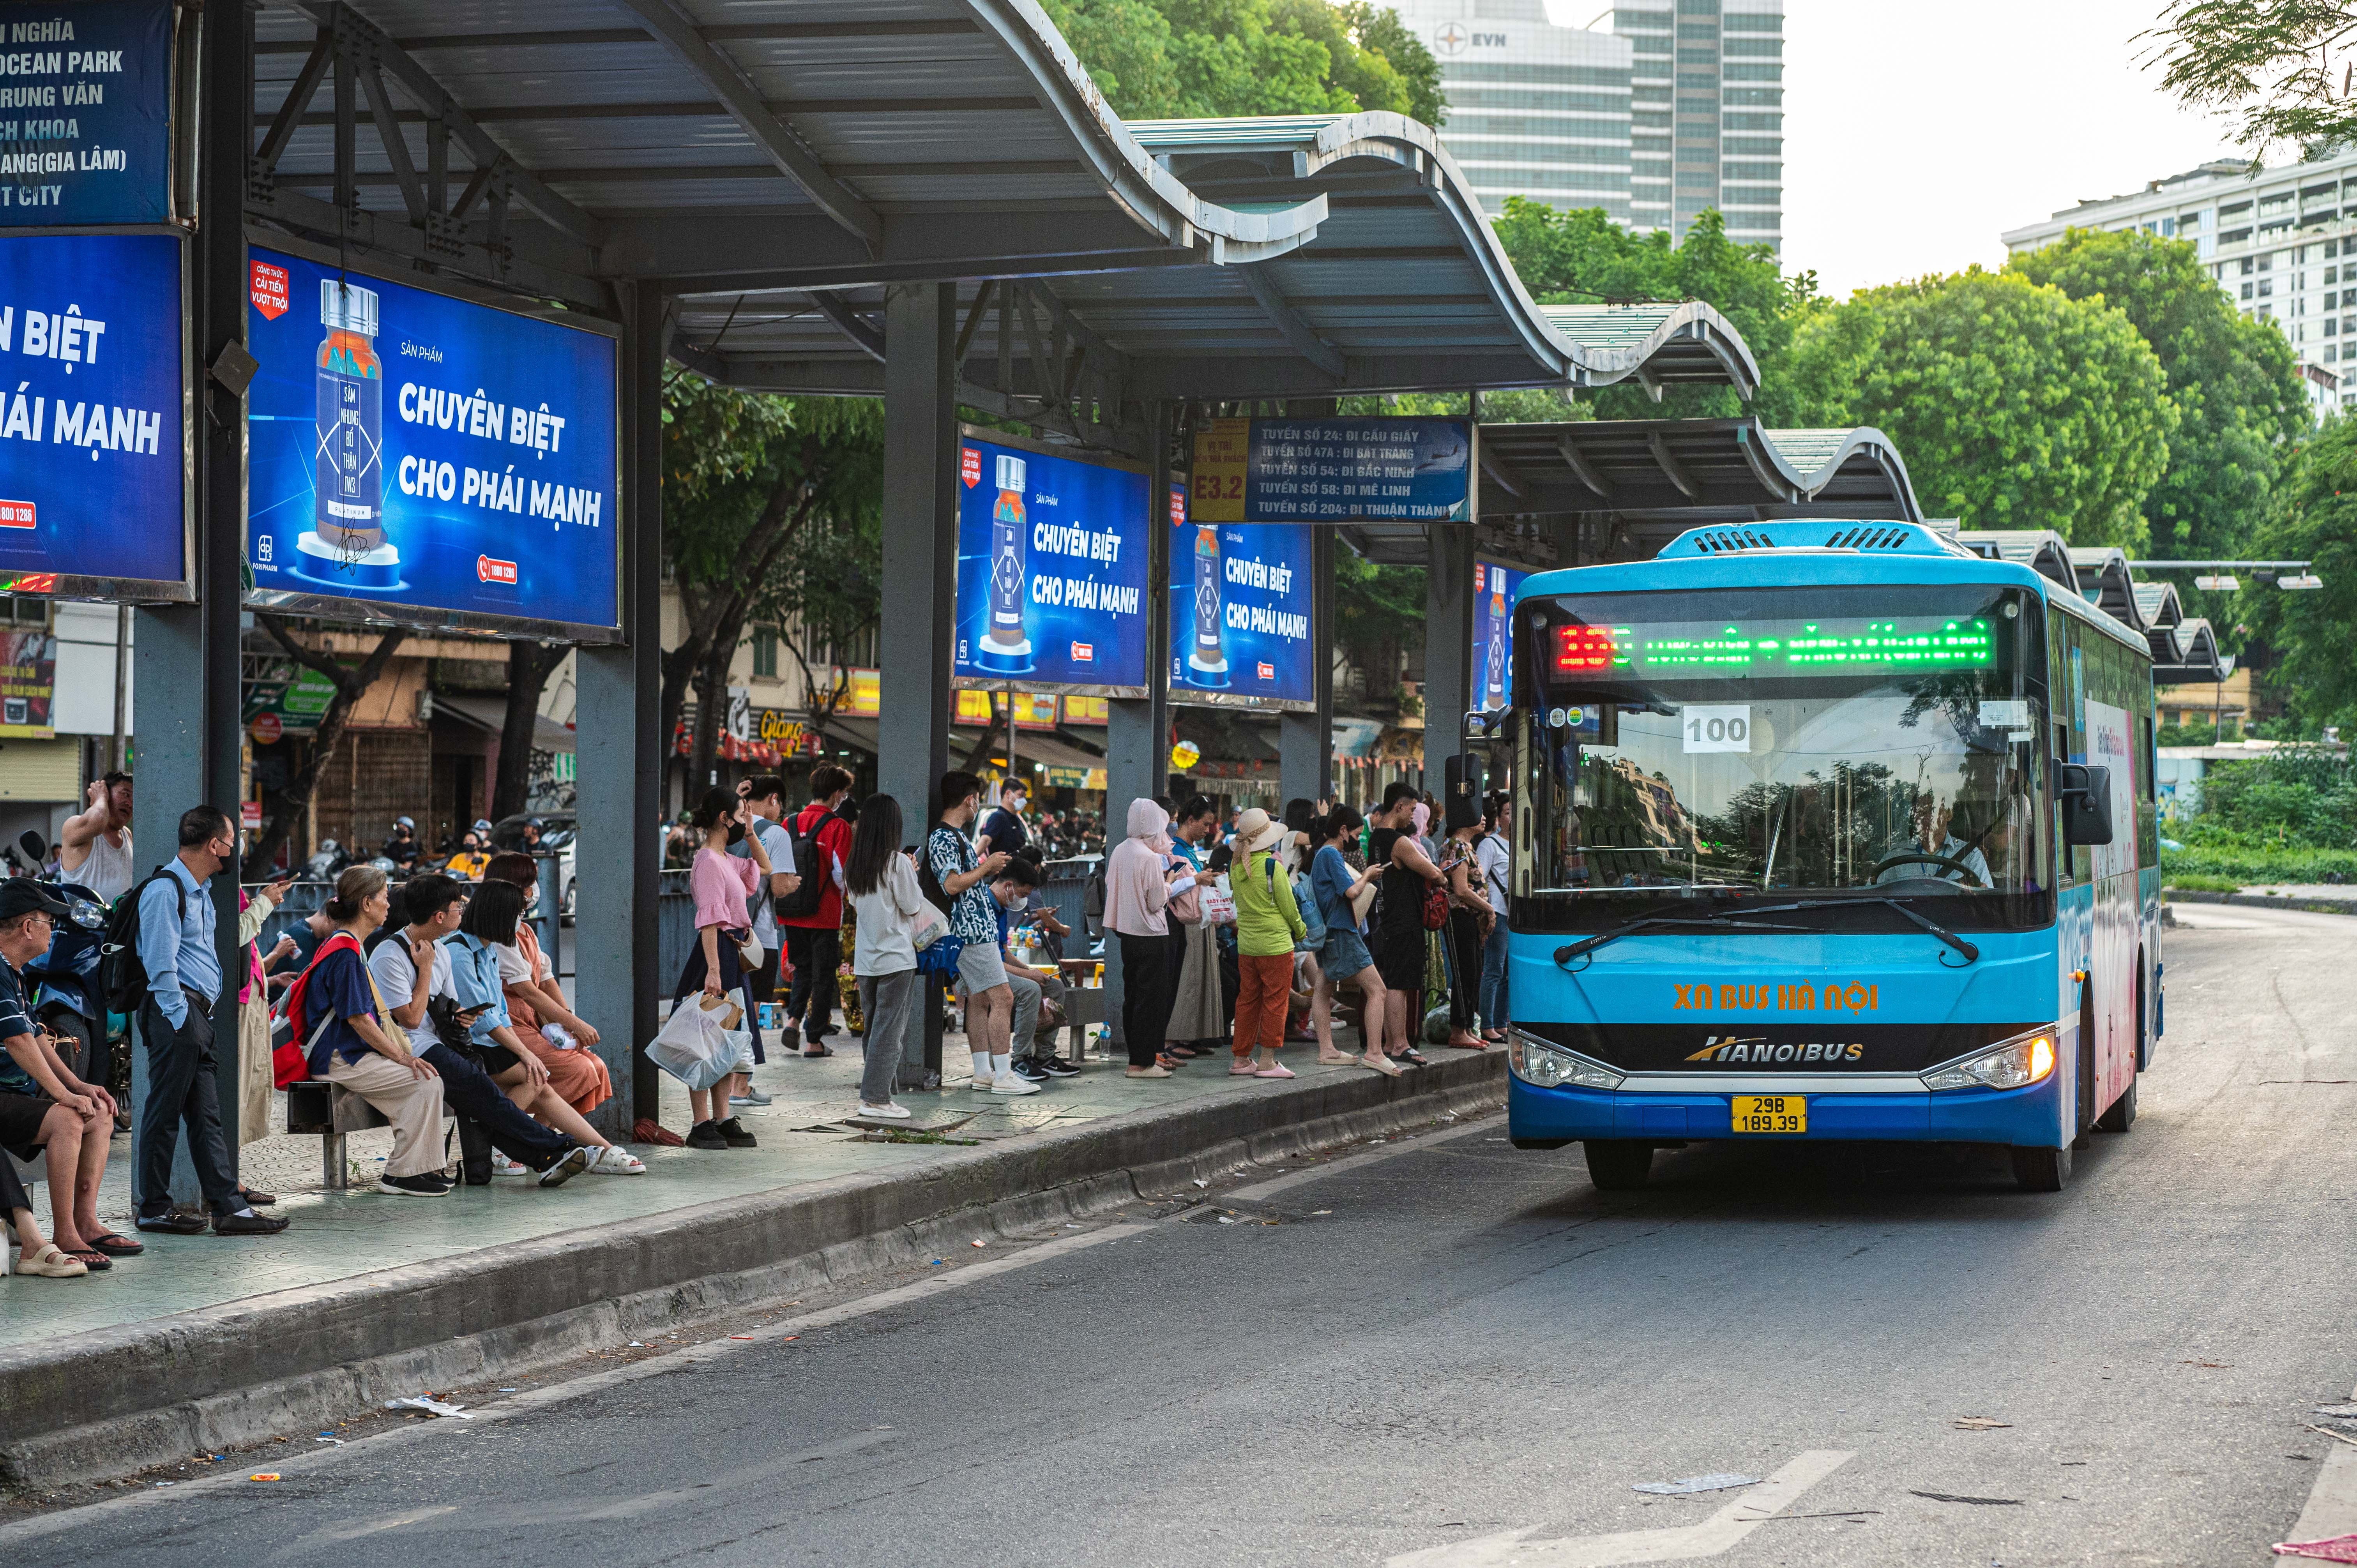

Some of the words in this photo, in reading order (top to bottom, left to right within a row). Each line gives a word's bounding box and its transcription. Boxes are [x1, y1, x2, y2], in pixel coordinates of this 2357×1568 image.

[12, 18, 74, 43] NGHĨA
[1472, 33, 1505, 47] EVN
[68, 51, 123, 73] PARK
[62, 81, 103, 106] VĂN
[25, 118, 79, 140] KHOA
[81, 145, 126, 171] LÂM)
[19, 185, 62, 206] CITY
[257, 265, 270, 275] CÔNG
[270, 268, 283, 279] THỨC
[255, 275, 267, 290] CẢI
[269, 276, 284, 294] TIẾN
[252, 291, 272, 305] VƯỢT
[272, 295, 288, 310] TRỘI
[23, 304, 106, 374] BIỆT
[401, 339, 417, 358] SẢN
[419, 344, 443, 364] PHẨM
[344, 385, 355, 404] SÂM
[341, 408, 359, 426] NHUNG
[399, 382, 505, 441] CHUYÊN
[510, 402, 565, 460] BIỆT
[53, 398, 161, 461] MẠNH
[346, 426, 354, 447] BỔ
[1262, 426, 1300, 440] TUYẾN
[1303, 427, 1321, 440] SỐ
[1323, 431, 1342, 441] 24:
[1346, 431, 1358, 441] ĐI
[1362, 427, 1387, 442] CẦU
[1390, 427, 1419, 443] GIẤY
[1261, 442, 1294, 457] TUYẾN
[1297, 443, 1312, 457] SỐ
[1314, 447, 1334, 458] 47A
[1343, 447, 1353, 458] ĐI
[343, 451, 357, 472] THẬN
[1260, 461, 1297, 475] TUYẾN
[1300, 461, 1317, 476] SỐ
[1320, 467, 1338, 476] 54:
[1341, 466, 1353, 477] ĐI
[1357, 464, 1381, 477] BẮC
[1384, 467, 1415, 478] NINH
[344, 475, 355, 493] TW3
[399, 455, 456, 501] CHO
[462, 464, 524, 514] PHÁI
[529, 480, 601, 532] MẠNH
[1195, 475, 1242, 499] E3.2
[1259, 479, 1298, 494] TUYẾN
[1301, 480, 1318, 494] SỐ
[1321, 485, 1339, 495] 58:
[1343, 485, 1356, 495] ĐI
[1360, 483, 1378, 496] MÊ
[1382, 486, 1410, 496] LINH
[1035, 493, 1045, 504] SẢN
[1258, 499, 1297, 513] TUYẾN
[1300, 500, 1317, 514] SỐ
[1320, 504, 1346, 515] 204:
[1349, 504, 1362, 515] ĐI
[1366, 502, 1406, 519] THUẬN
[0, 507, 14, 521] 800
[16, 508, 32, 522] 1286
[335, 507, 365, 515] PLATINUM
[1034, 521, 1088, 558] CHUYÊN
[1091, 526, 1121, 569] BIỆT
[253, 563, 278, 572] FORIPHARM
[491, 565, 503, 577] 1800
[503, 567, 514, 579] 1286
[1226, 556, 1267, 589] CHUYÊN
[1269, 562, 1292, 599] BIỆT
[1032, 574, 1062, 605] CHO
[1065, 573, 1097, 609] PHÁI
[1100, 584, 1139, 620] MẠNH
[1226, 602, 1249, 629] CHO
[1251, 602, 1276, 634] PHÁI
[1277, 614, 1307, 644] MẠNH
[1687, 718, 1747, 742] 100
[1720, 985, 1770, 1010] BUS
[1778, 978, 1815, 1010] HÀ
[1824, 980, 1878, 1016] NỘI
[1684, 1036, 1864, 1062] HANOIBUS
[1753, 1097, 1785, 1113] 29B
[1742, 1115, 1798, 1131] 189.39
